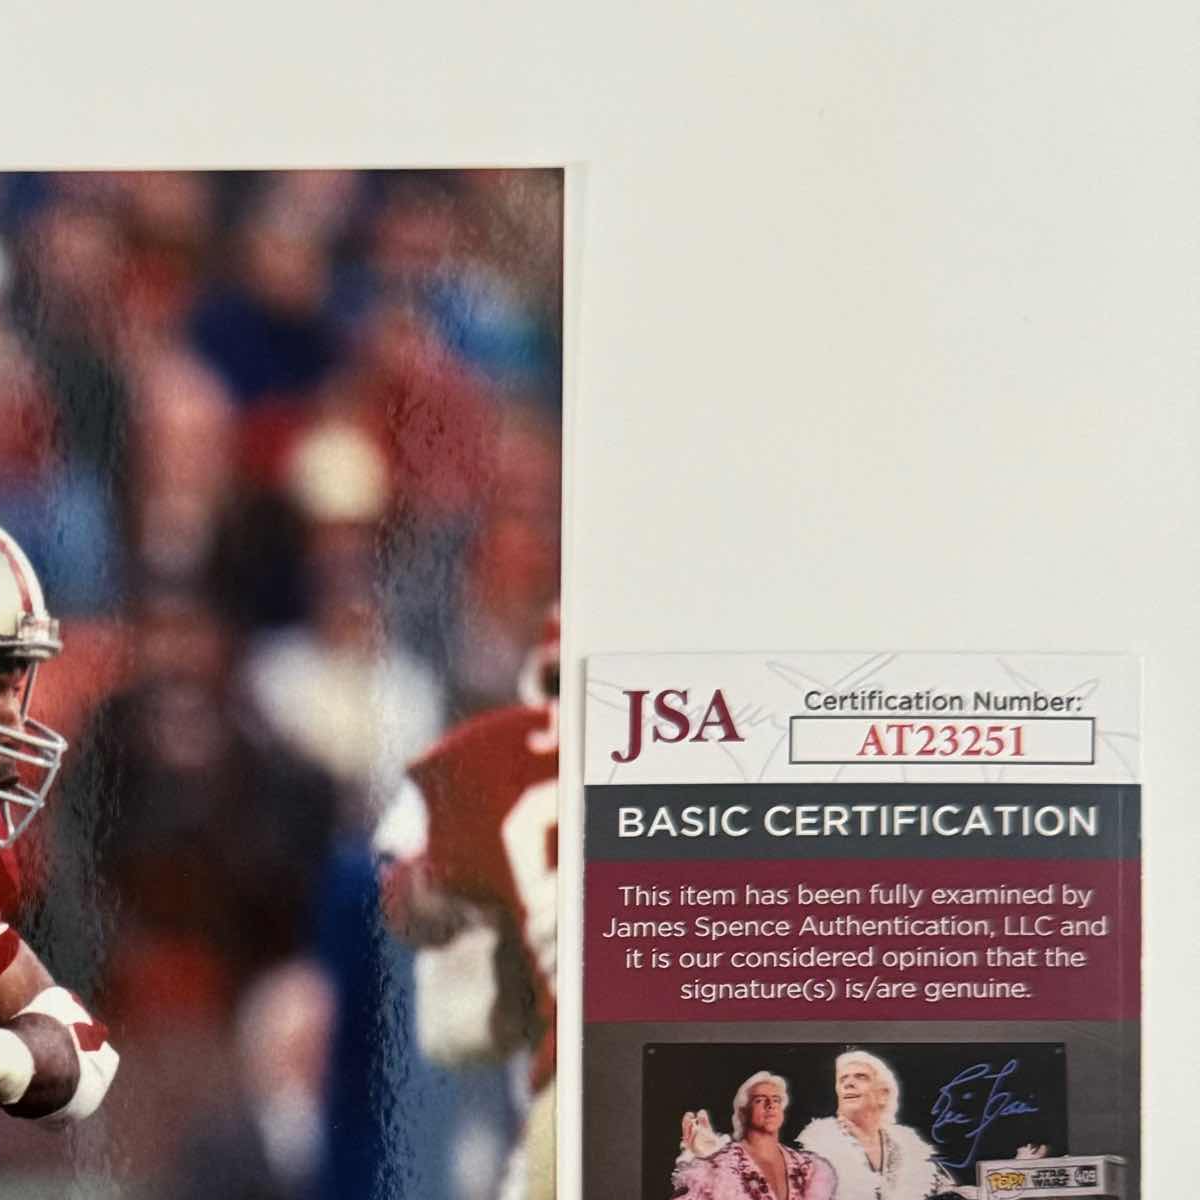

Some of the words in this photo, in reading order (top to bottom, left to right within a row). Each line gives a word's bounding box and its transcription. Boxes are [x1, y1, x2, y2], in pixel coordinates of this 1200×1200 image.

[804, 689, 963, 711] Certification
[972, 691, 1083, 711] Number:
[611, 688, 745, 763] JSA
[856, 723, 1025, 757] AT23251
[618, 807, 749, 837] BASIC
[764, 805, 1098, 836] CERTIFICATION
[619, 886, 671, 907] This
[679, 886, 735, 906] item
[746, 886, 788, 905] has
[798, 885, 861, 905] been
[869, 884, 922, 909] fully
[931, 885, 1056, 905] examined
[1063, 885, 1093, 908] by
[602, 917, 686, 938] James
[694, 917, 789, 942] Spence
[798, 916, 997, 939] Authentication,
[1004, 917, 1052, 936] LLC
[1060, 916, 1109, 936] and
[626, 948, 642, 968] it
[651, 948, 669, 968] is
[679, 952, 722, 968] our
[731, 947, 873, 968] considered
[882, 948, 977, 972] opinion
[987, 947, 1036, 967] that
[1044, 947, 1086, 967] the
[680, 978, 835, 1003] signature(s)
[845, 977, 915, 1000] is/are
[925, 979, 1032, 1003] genuine.
